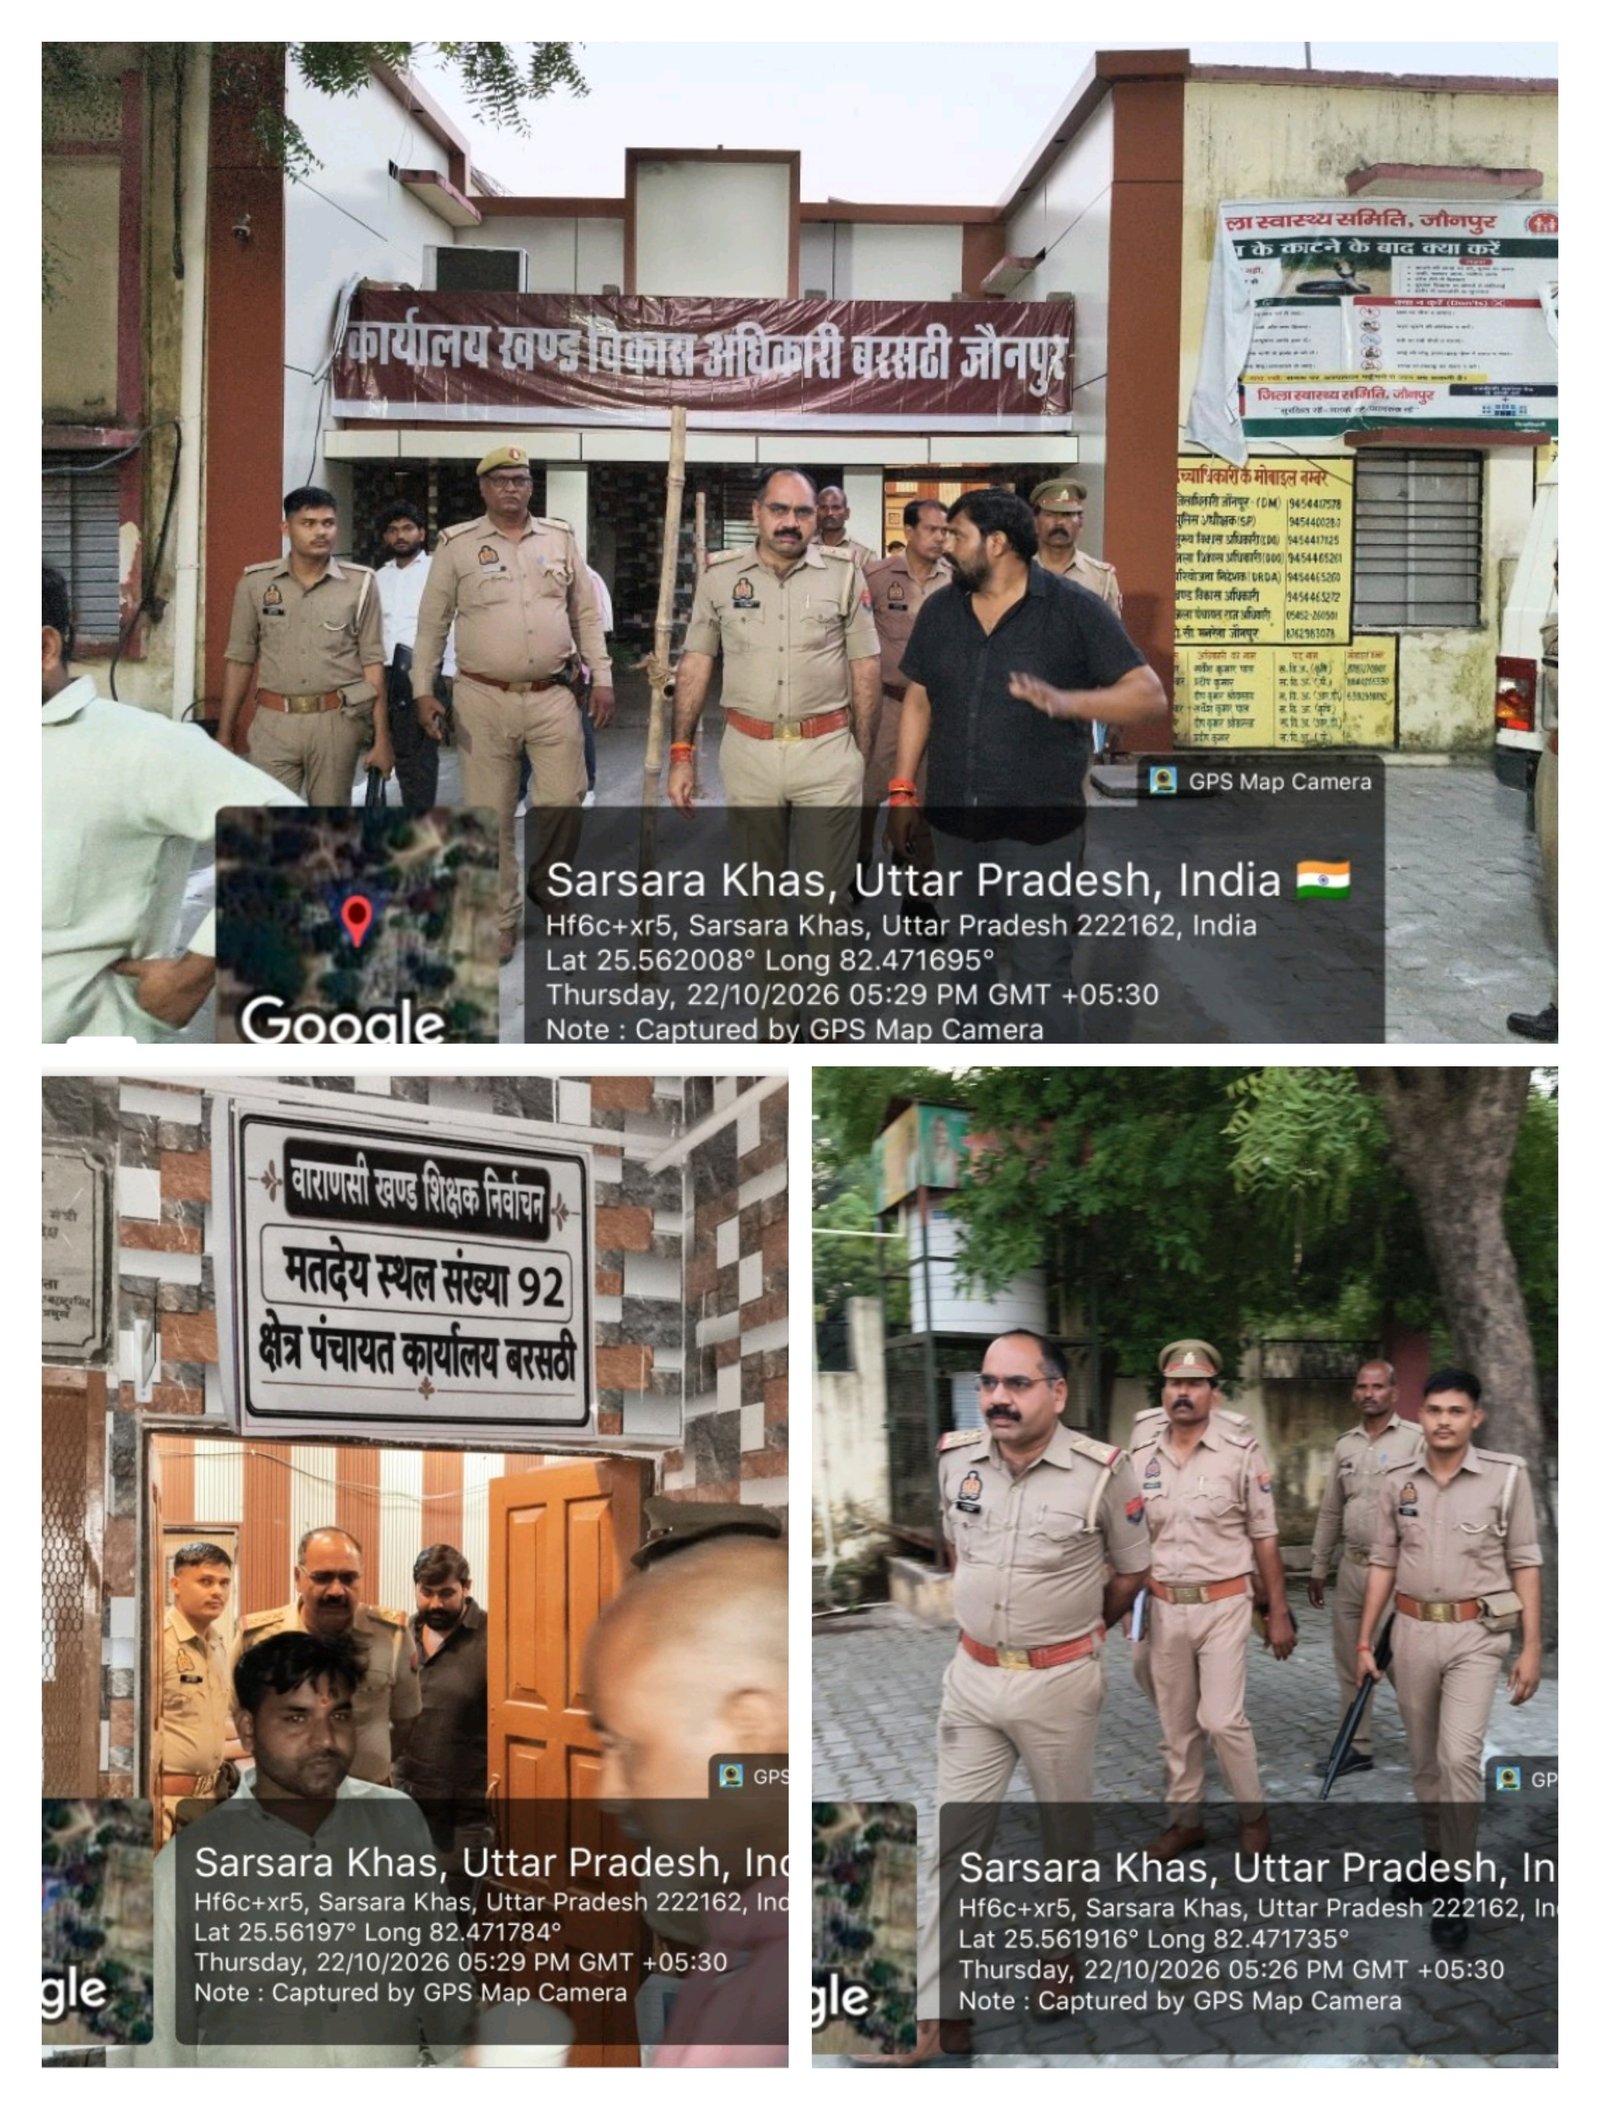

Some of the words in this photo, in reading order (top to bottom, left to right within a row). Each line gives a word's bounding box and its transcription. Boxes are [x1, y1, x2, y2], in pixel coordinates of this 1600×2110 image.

[1252, 241, 1274, 257] के
[1281, 238, 1342, 254] काटने
[1349, 238, 1370, 254] के
[1377, 241, 1415, 255] बाद
[1422, 242, 1460, 255] क्या
[1467, 240, 1502, 256] करें
[1256, 213, 1332, 229] स्वास्थ्य
[1419, 209, 1497, 235] जौनपुर
[348, 307, 492, 369] कार्यालय
[498, 326, 583, 373] खण्ड
[585, 317, 698, 377] विकास
[702, 320, 844, 380] अधिकारी
[960, 323, 1069, 397] जौनपुर
[1177, 464, 1239, 485] च्चाधिकारी
[290, 1152, 369, 1205] वाराणसी
[374, 1168, 418, 1211] खण्ड
[422, 1160, 480, 1219] शिक्षक
[483, 1166, 546, 1224] निर्वाचन
[282, 1235, 371, 1302] मतदेय
[375, 1254, 438, 1303] स्थल
[441, 1247, 510, 1307] संख्या
[518, 1266, 565, 1308] 92
[259, 1308, 303, 1373] क्षेत्र
[308, 1313, 396, 1374] पंचायत
[400, 1321, 500, 1379] कार्यालय
[504, 1328, 577, 1381] बरसठी
